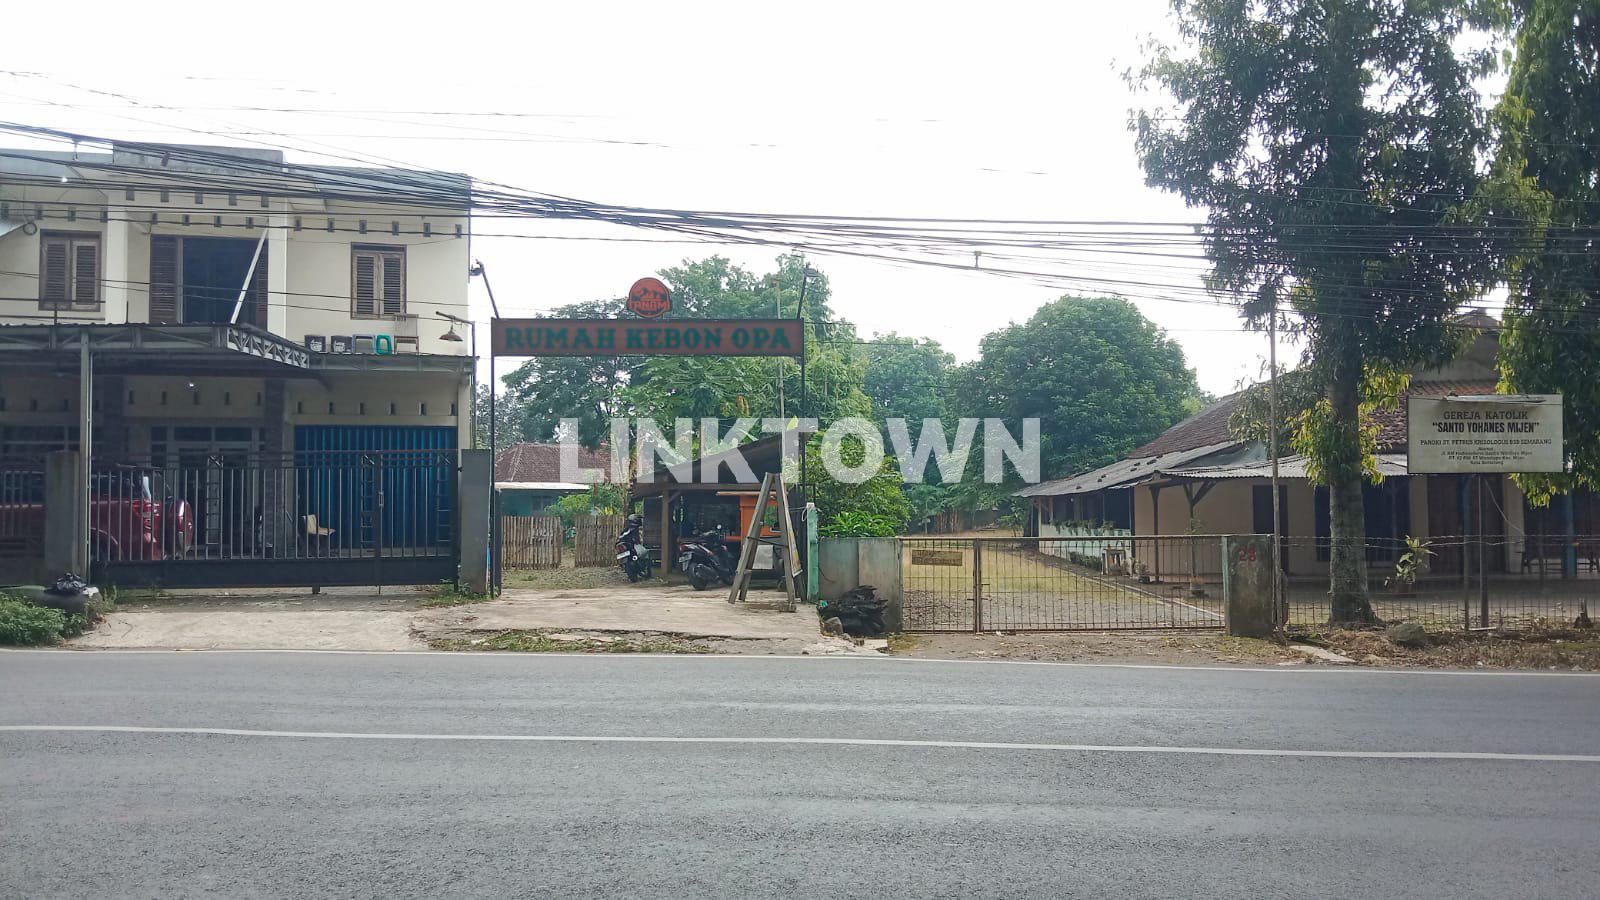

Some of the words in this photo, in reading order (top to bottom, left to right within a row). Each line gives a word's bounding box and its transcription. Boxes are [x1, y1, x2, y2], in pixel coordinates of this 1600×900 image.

[505, 327, 617, 350] RUMAH
[626, 327, 722, 350] KEBON
[732, 327, 791, 349] OPA
[1443, 411, 1481, 420] GEREJA
[1485, 411, 1529, 420] KATOLIK
[1467, 422, 1505, 433] YOHANES
[1238, 547, 1257, 561] 28
